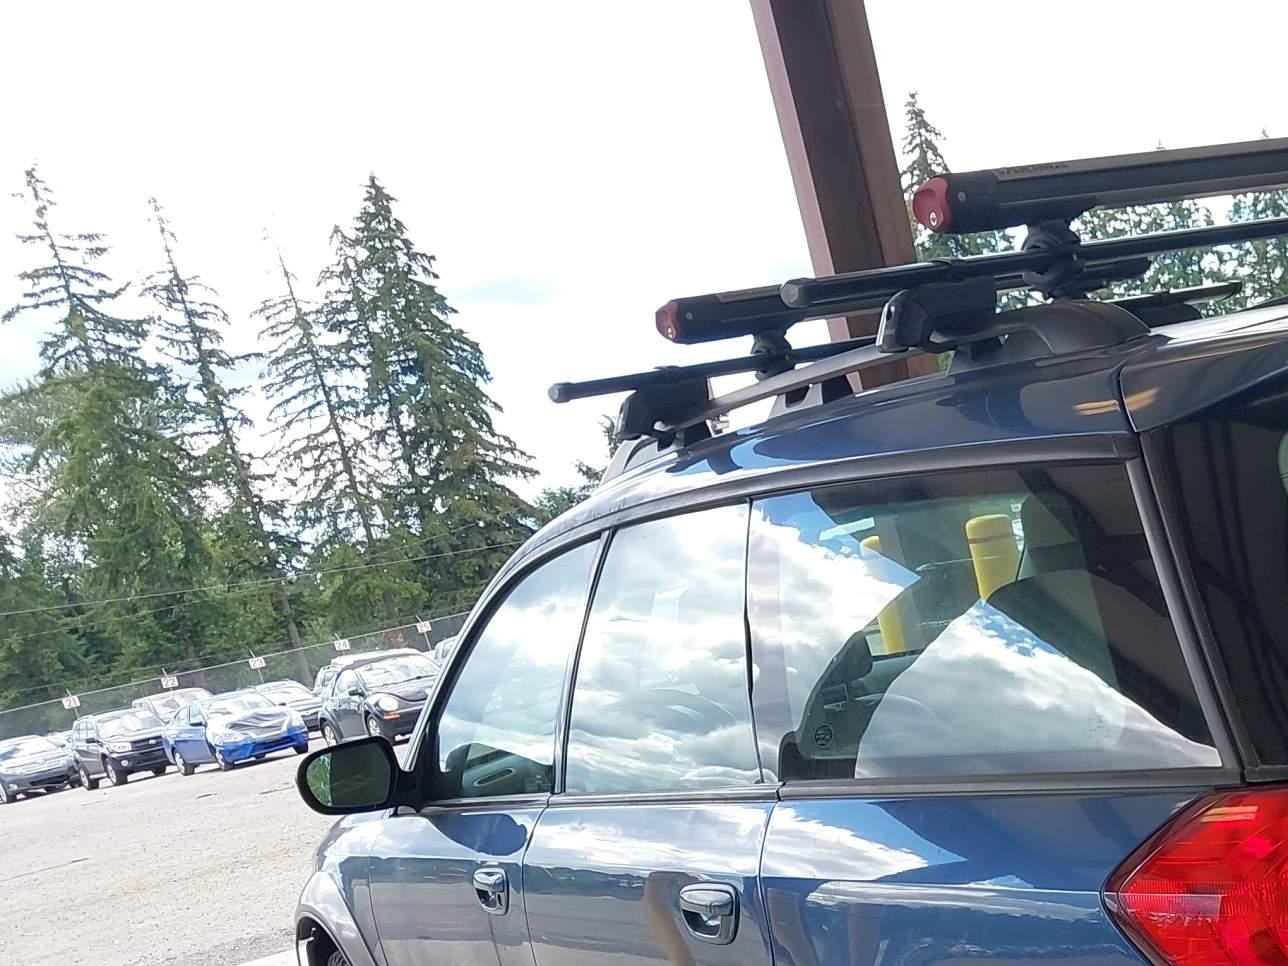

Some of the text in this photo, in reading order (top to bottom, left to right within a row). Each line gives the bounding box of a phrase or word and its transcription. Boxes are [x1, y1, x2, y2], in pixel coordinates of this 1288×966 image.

[417, 622, 430, 632] 25
[335, 640, 348, 650] 24
[250, 658, 264, 668] 23
[162, 677, 177, 687] 22
[64, 696, 78, 708] 21
